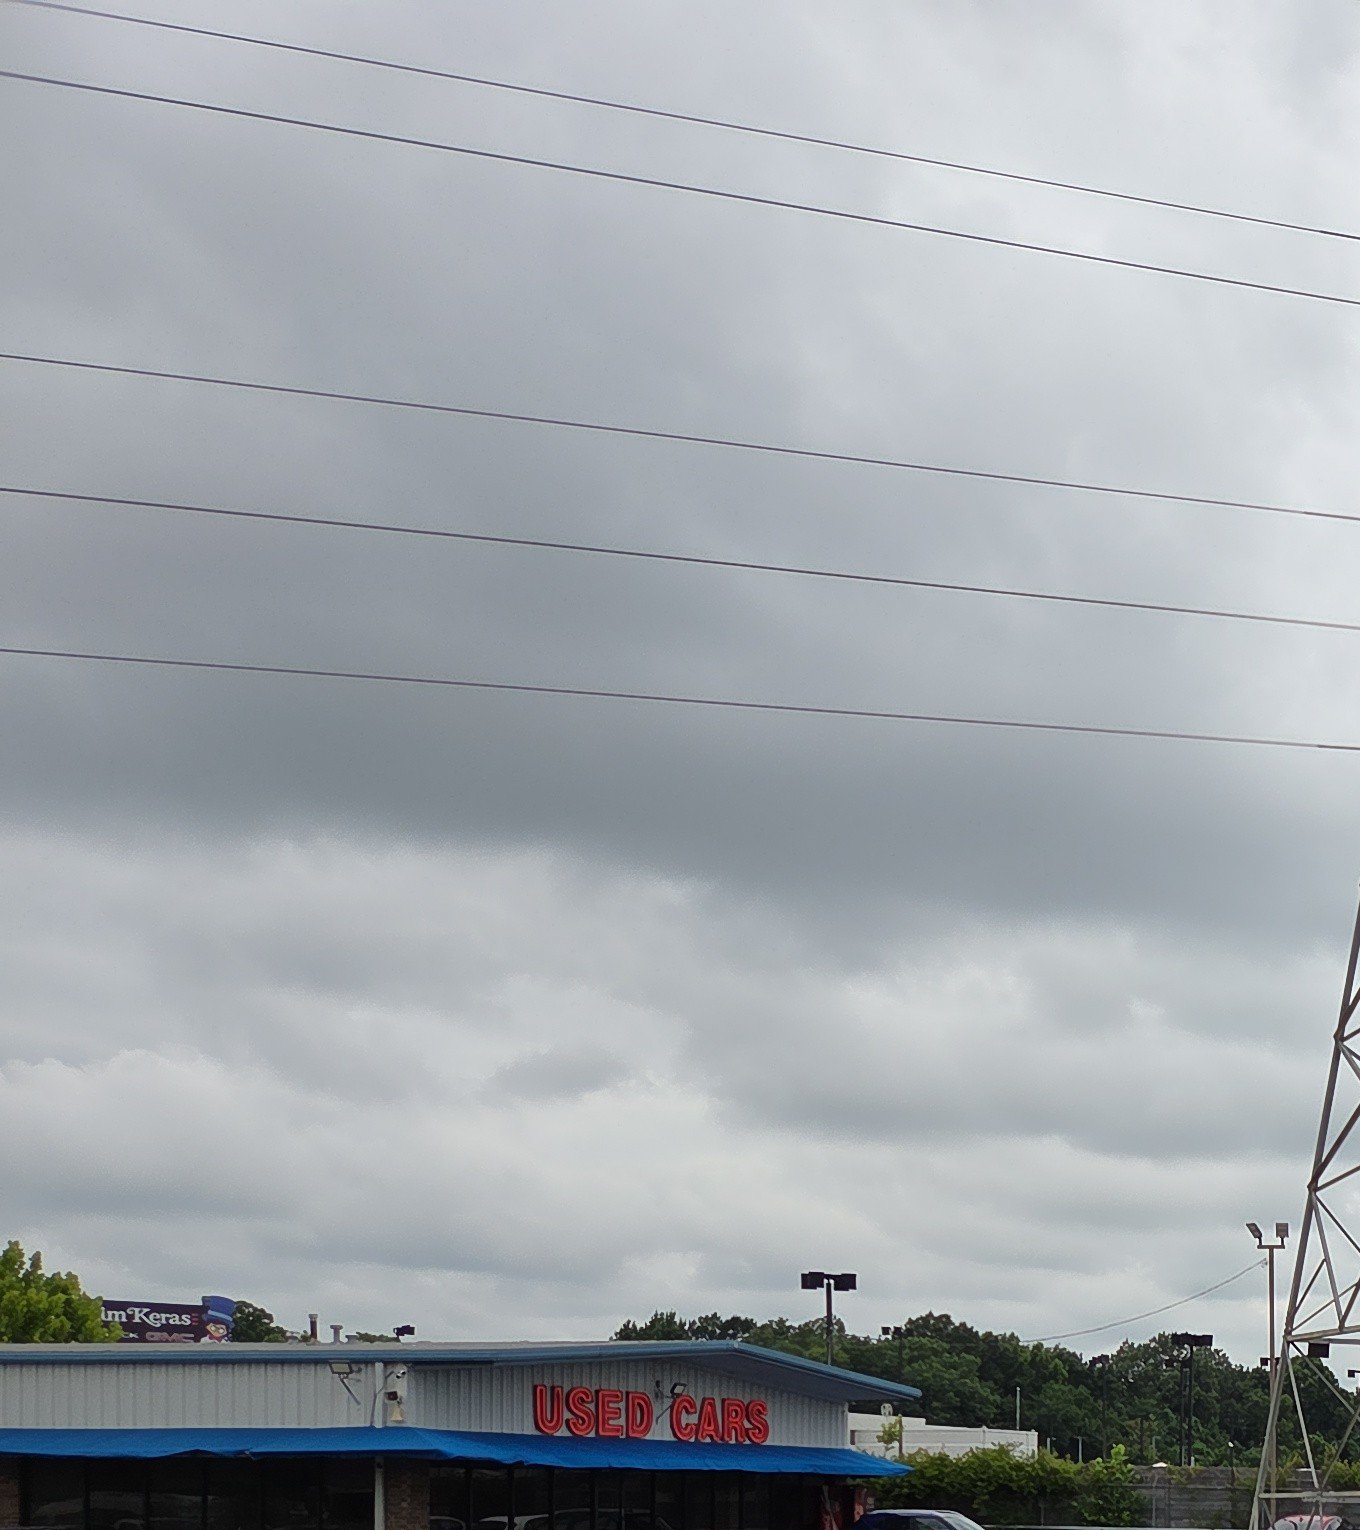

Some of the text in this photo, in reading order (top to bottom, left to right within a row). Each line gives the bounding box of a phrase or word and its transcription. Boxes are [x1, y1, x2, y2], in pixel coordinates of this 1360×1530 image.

[101, 1307, 192, 1327] im Keras
[145, 1331, 195, 1343] GMC
[533, 1384, 770, 1444] USED CARS
